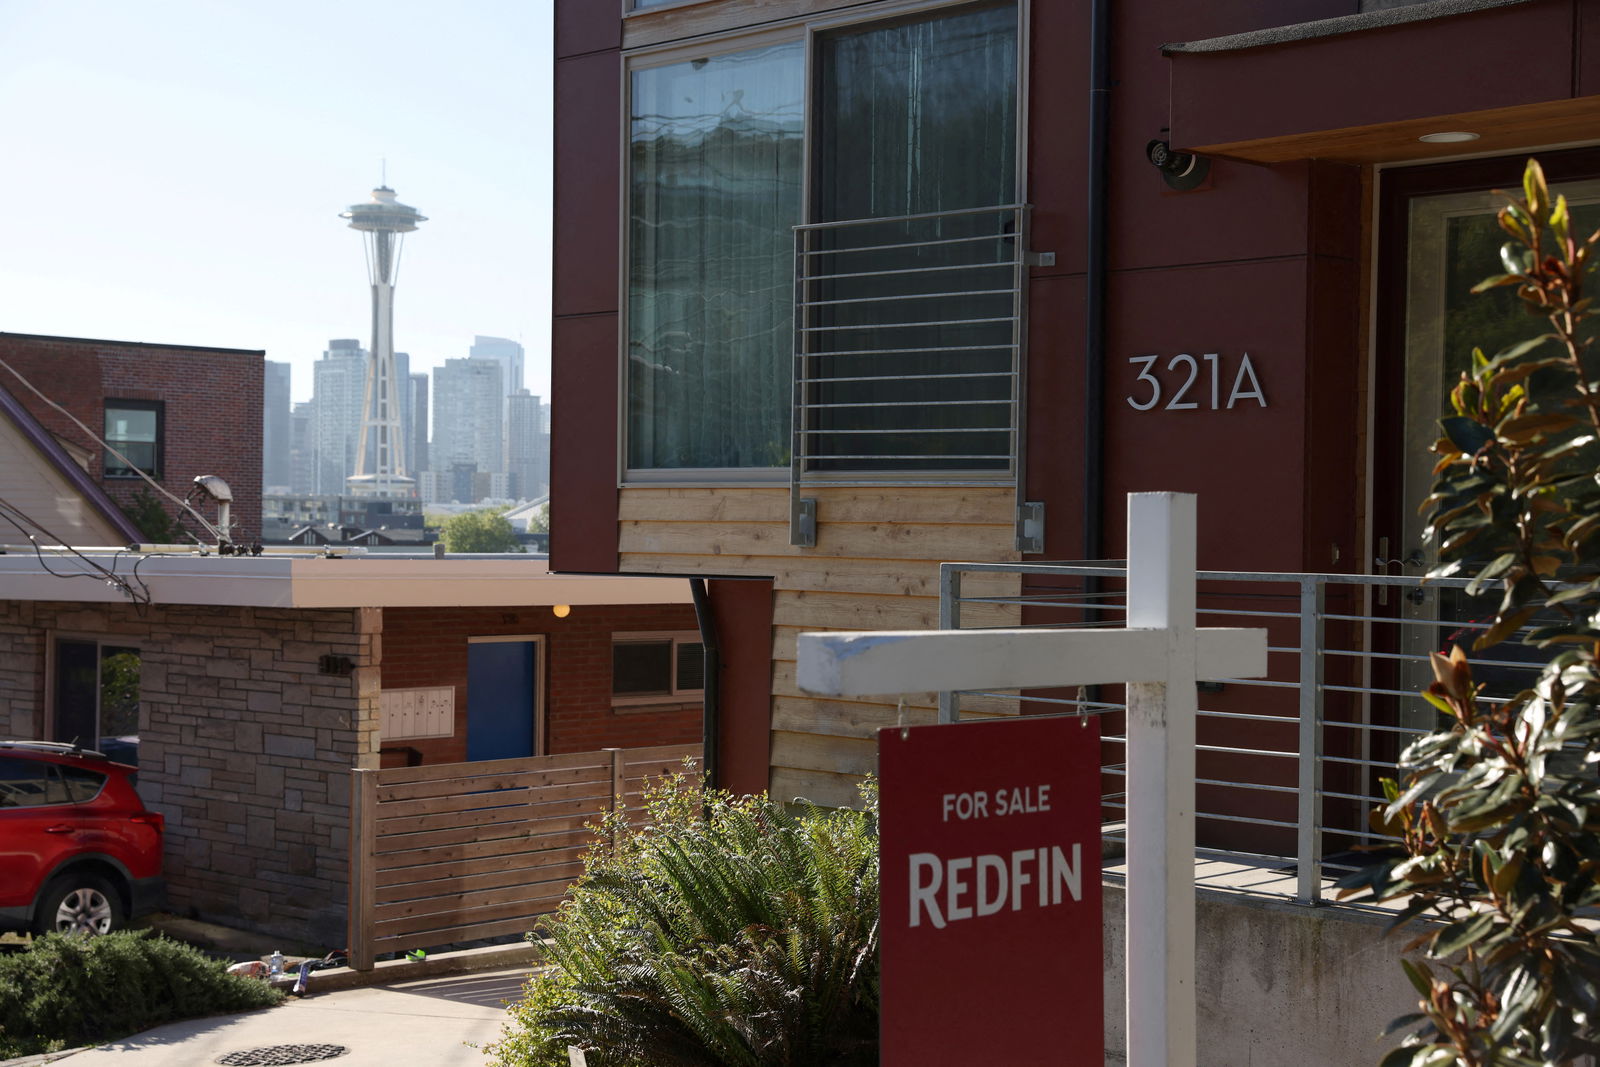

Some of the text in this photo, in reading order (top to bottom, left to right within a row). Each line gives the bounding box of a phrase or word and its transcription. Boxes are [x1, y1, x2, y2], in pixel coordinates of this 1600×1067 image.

[1126, 352, 1267, 411] 321A
[943, 784, 1051, 822] FOR SALE
[908, 843, 1082, 929] REDFIN
